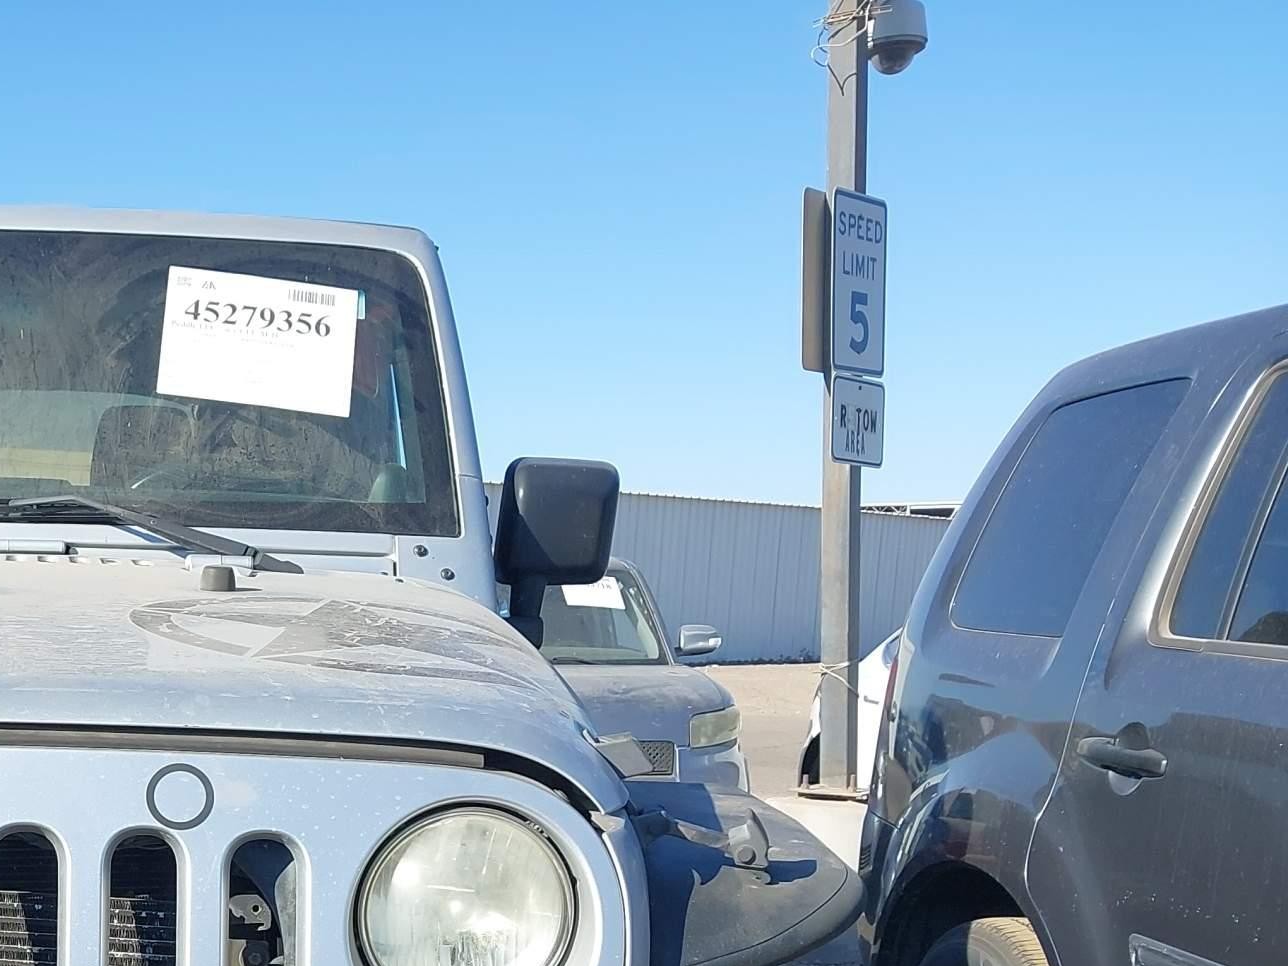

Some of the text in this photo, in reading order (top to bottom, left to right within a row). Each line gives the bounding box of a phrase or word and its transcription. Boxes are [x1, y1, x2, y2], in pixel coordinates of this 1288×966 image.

[838, 213, 882, 244] SPEED
[842, 253, 877, 281] LIMIT
[184, 299, 331, 337] 45279356
[849, 290, 869, 355] 5
[856, 407, 877, 433] TOW
[845, 429, 865, 456] AREA
